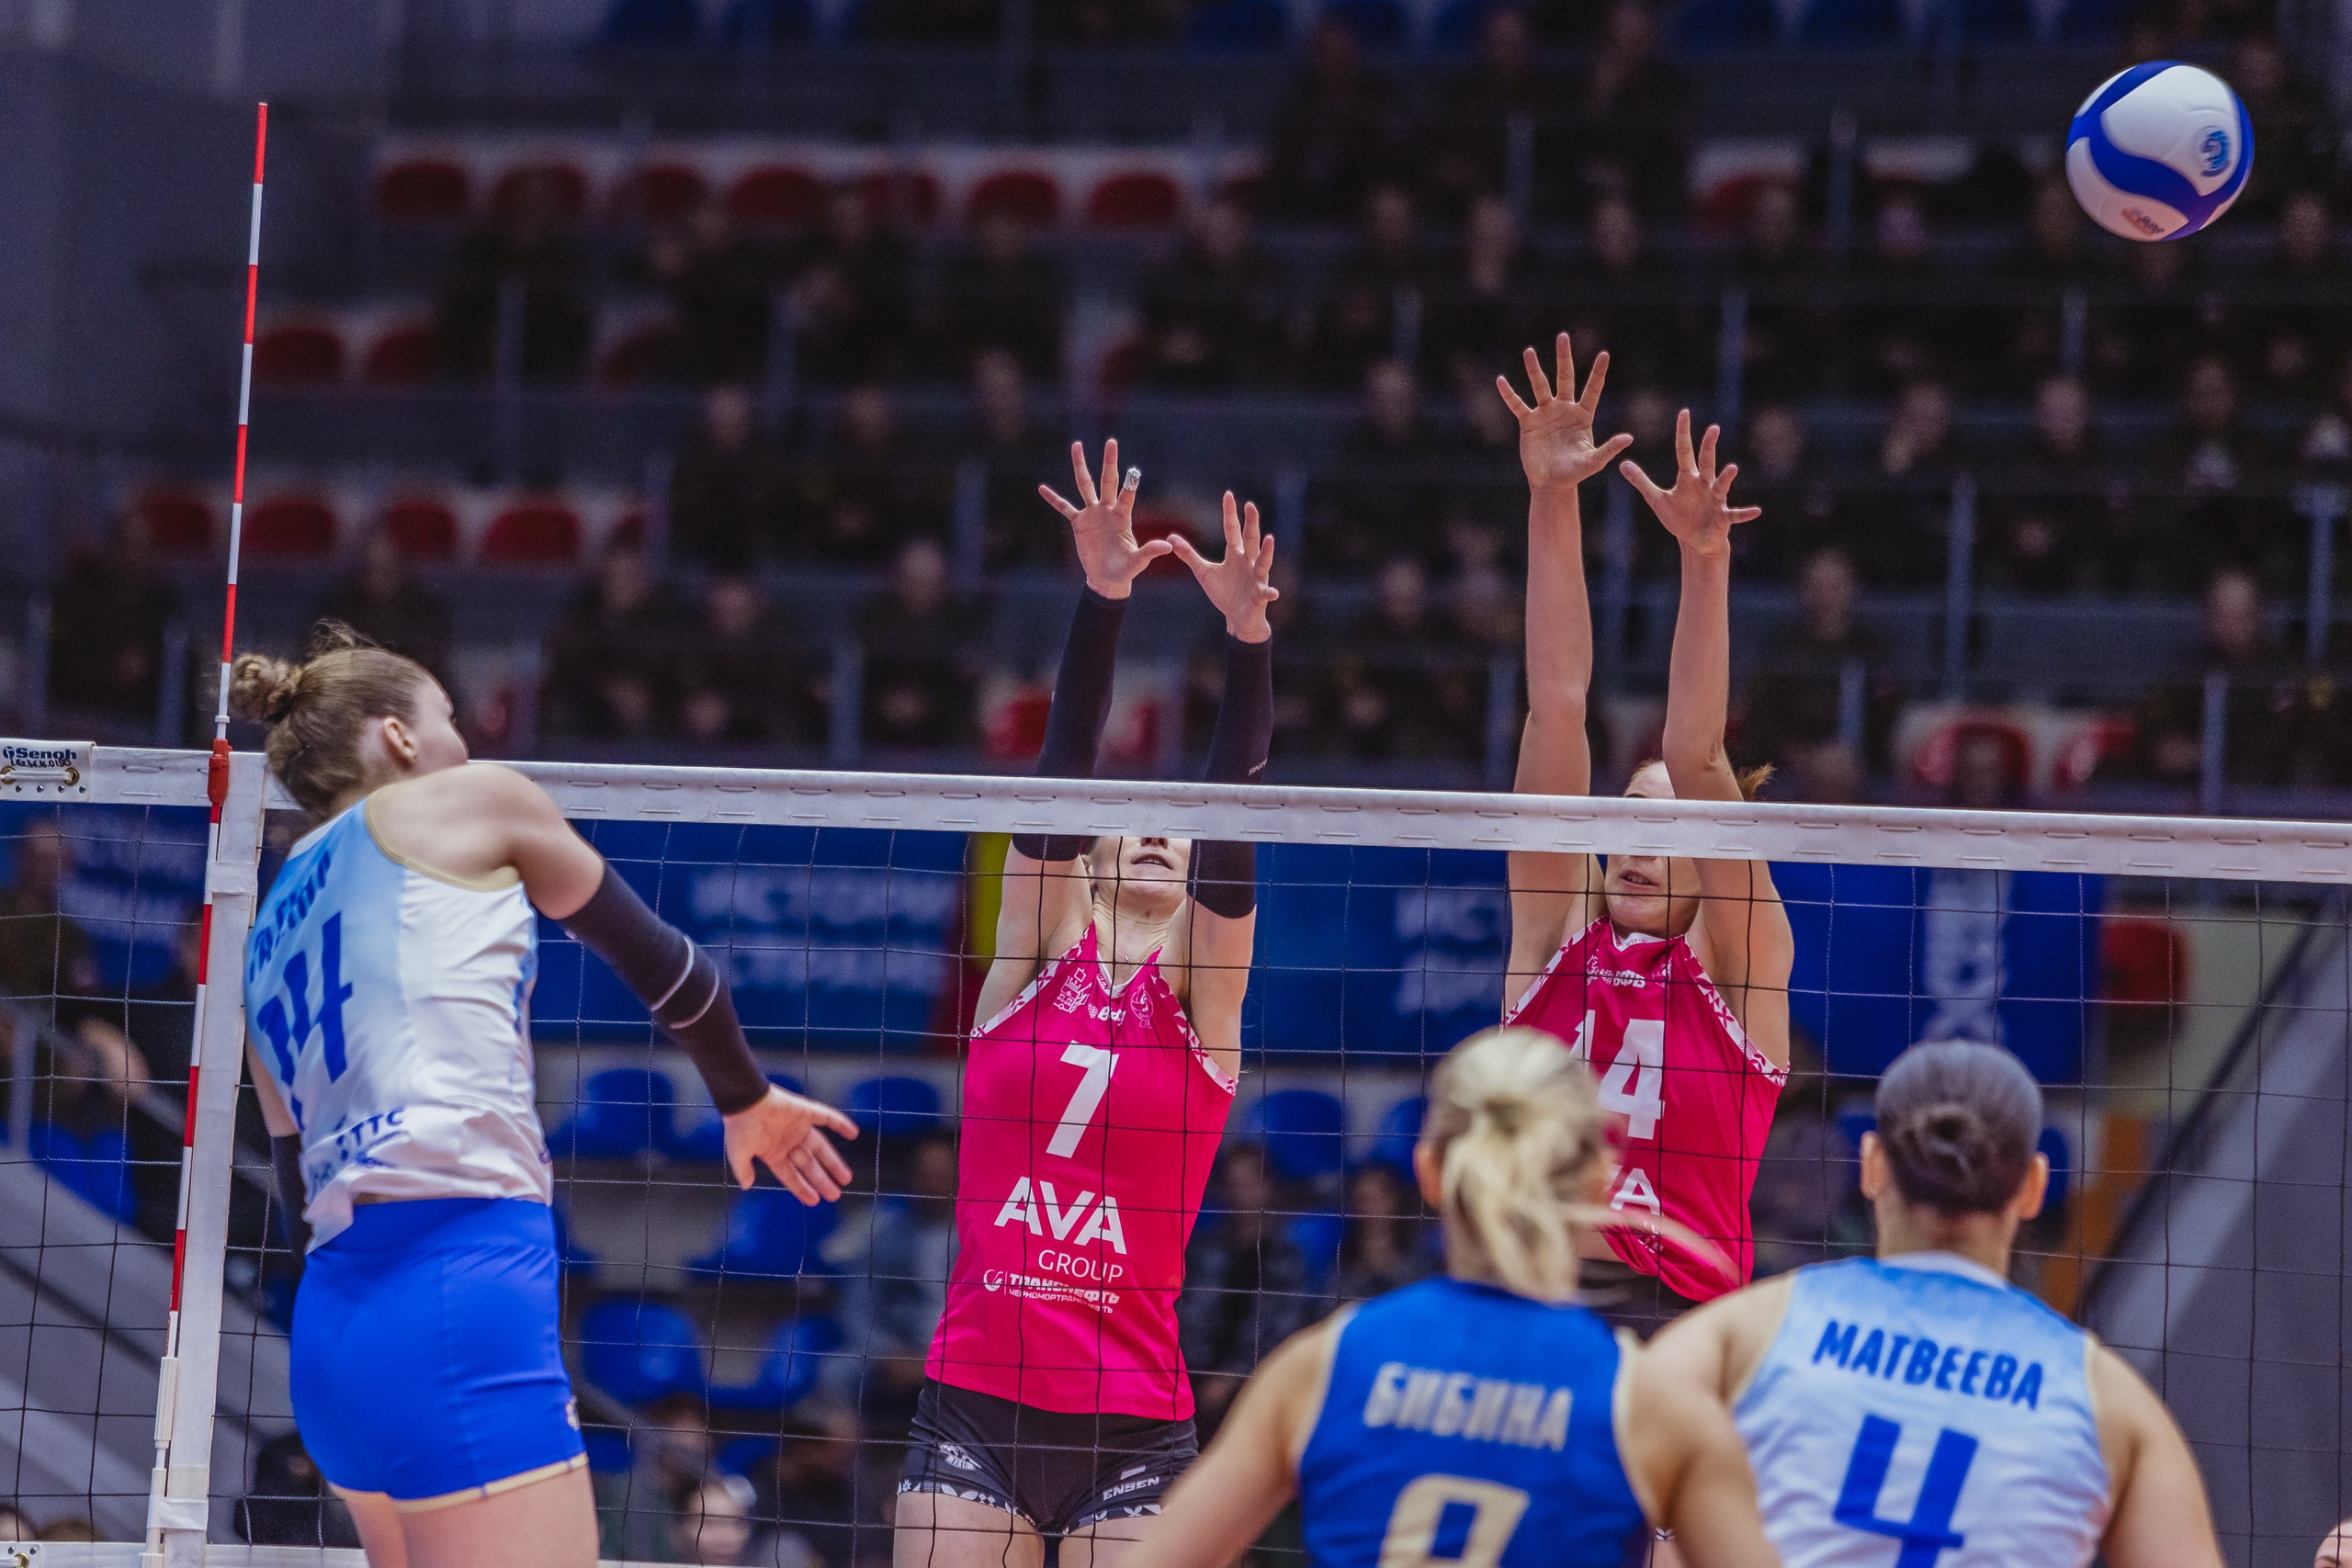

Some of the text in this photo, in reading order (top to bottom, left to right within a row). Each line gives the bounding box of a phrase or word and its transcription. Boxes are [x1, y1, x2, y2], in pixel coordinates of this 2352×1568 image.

[1046, 1039, 1120, 1159] 7
[993, 1176, 1127, 1256] AVA
[1037, 1249, 1124, 1284] GROUP
[1363, 1361, 1573, 1452] БИБИНА
[1812, 1319, 2043, 1411] МАТВЕЕВА
[1102, 1475, 1159, 1501] ENSEN
[1833, 1413, 1980, 1568] 4
